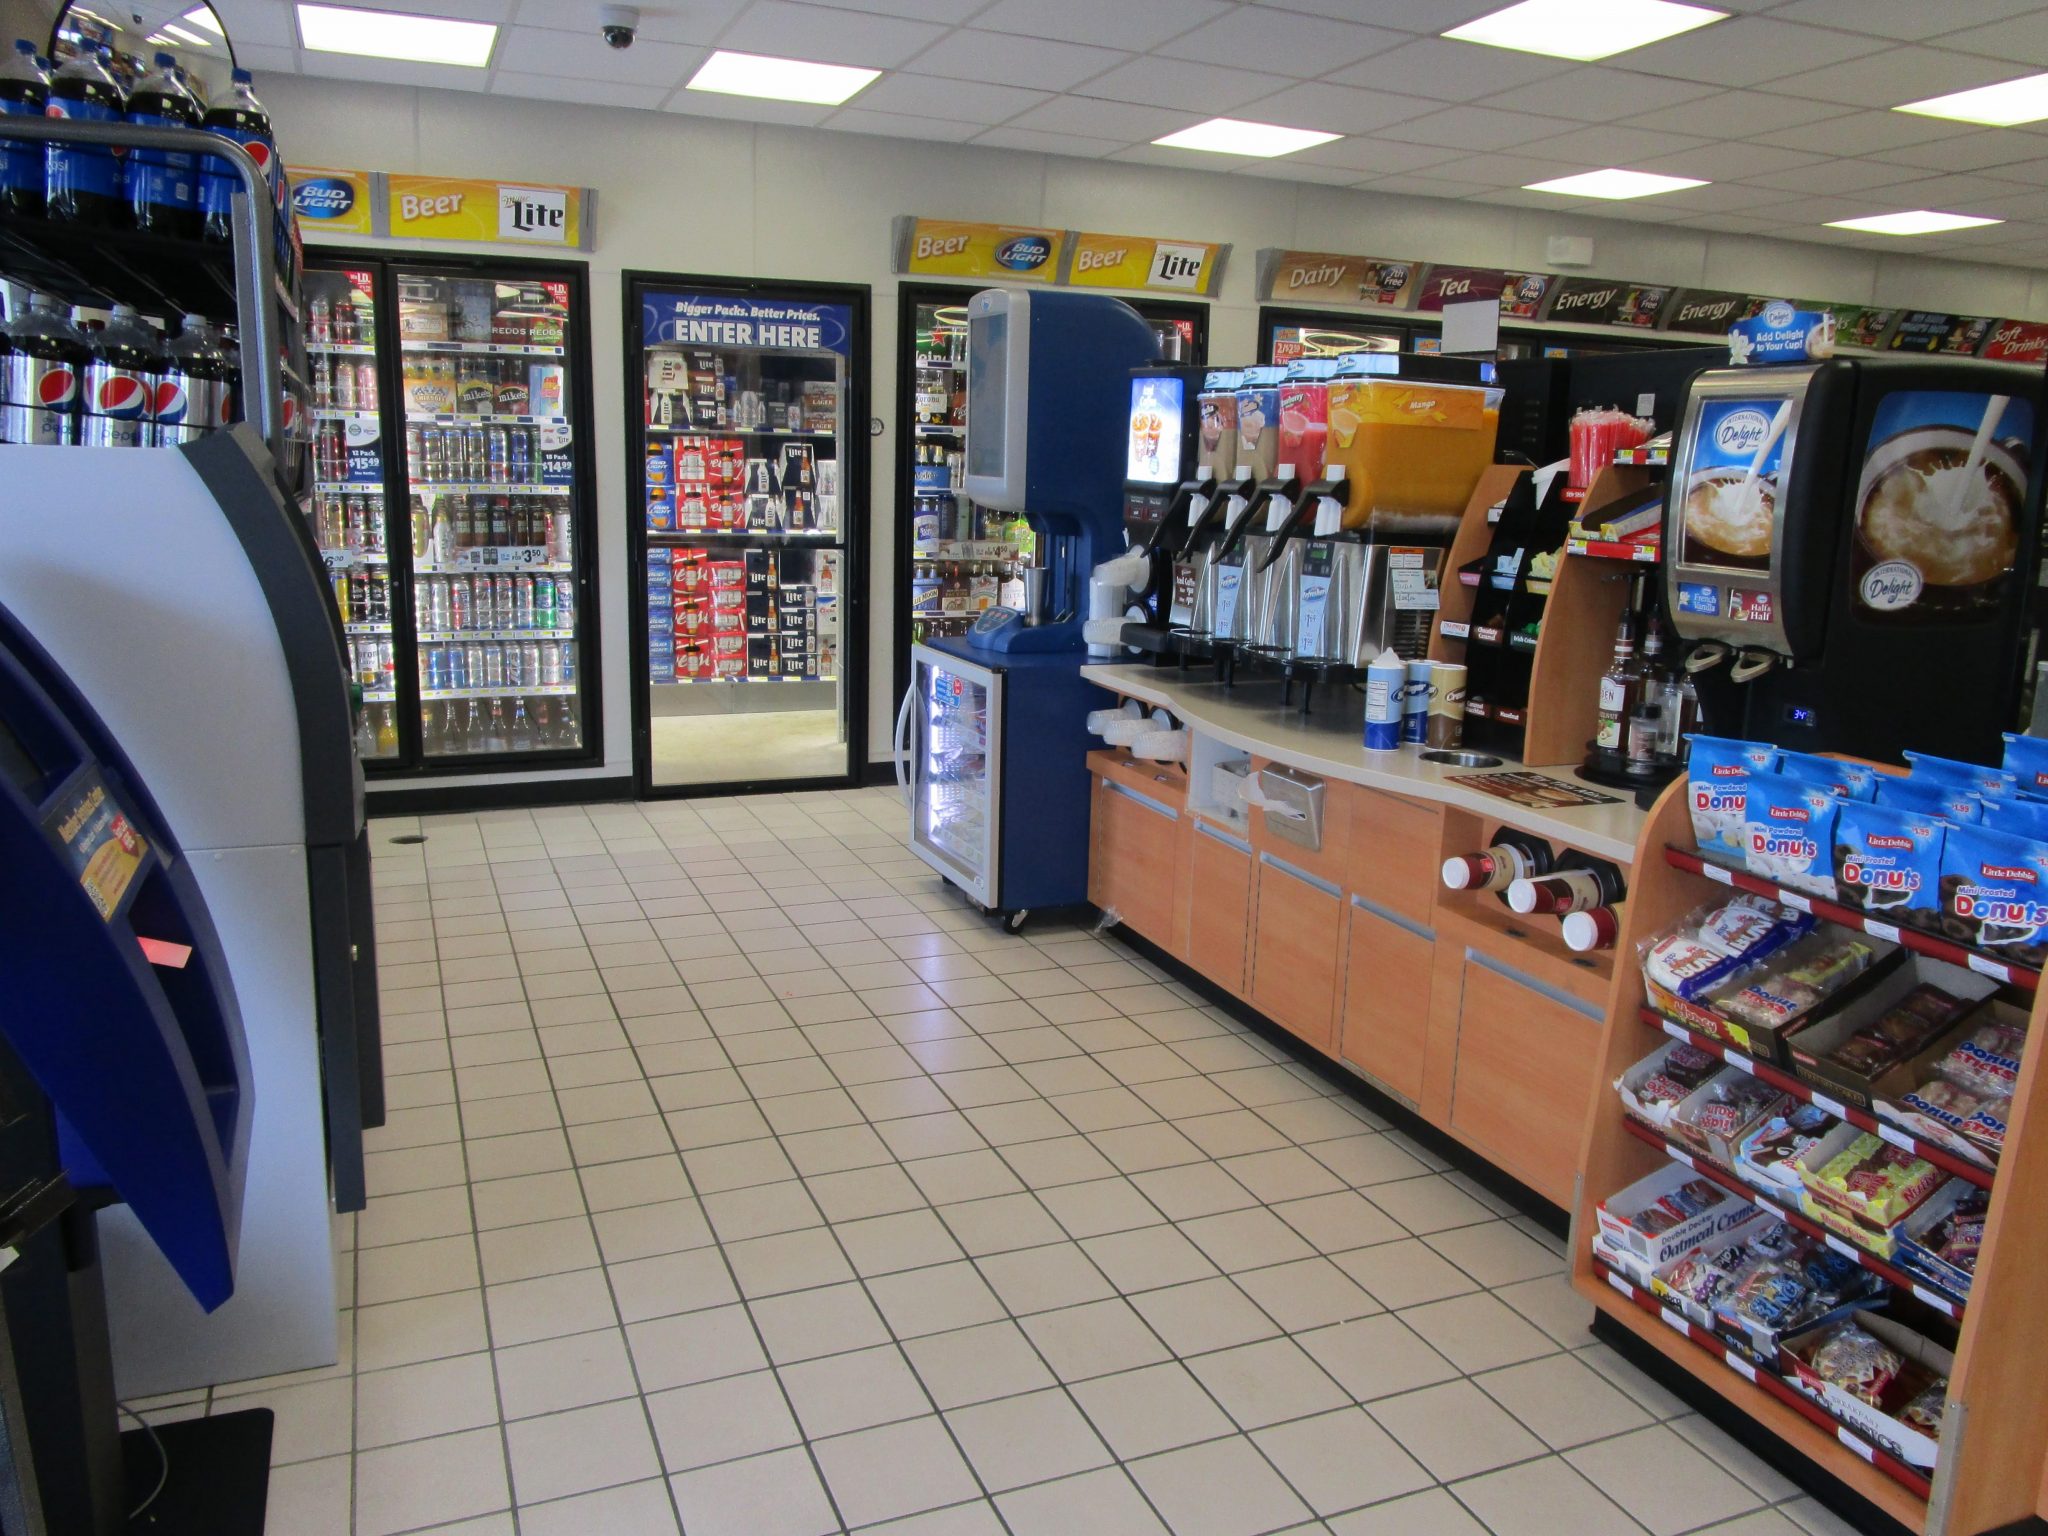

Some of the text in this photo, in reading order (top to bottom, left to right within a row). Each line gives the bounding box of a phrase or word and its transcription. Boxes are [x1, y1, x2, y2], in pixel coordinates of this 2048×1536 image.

[302, 186, 346, 199] BUD
[294, 196, 351, 209] LIGHT
[401, 192, 463, 221] Beer
[512, 201, 564, 232] Lite
[916, 233, 969, 259] Beer
[1012, 243, 1044, 254] BUD
[1002, 252, 1047, 263] LIGHT
[1077, 248, 1127, 272] Beer
[1159, 254, 1201, 281] Lite
[1389, 268, 1404, 278] 7th
[1289, 263, 1346, 288] Dairy
[1384, 276, 1404, 286] Free
[1439, 277, 1471, 297] Tea
[1527, 280, 1540, 290] 7th
[1520, 289, 1539, 298] Free
[1556, 287, 1619, 310] Energy
[1641, 300, 1658, 309] Free
[1679, 301, 1736, 321] Energy
[675, 302, 821, 321] Bigger Packs. Better Prices.
[674, 319, 820, 349] ENTER HERE
[1756, 329, 1804, 341] Add Delight
[1991, 326, 2022, 345] Soft
[1757, 340, 1803, 352] to Your Cup!
[2003, 337, 2046, 355] Drinks
[661, 359, 676, 382] Lite
[699, 360, 714, 370] Lite
[701, 384, 715, 394] Lite
[1409, 400, 1436, 410] Mango
[702, 409, 717, 418] Lite
[1722, 421, 1763, 449] Delight
[553, 454, 568, 462] Pack
[788, 448, 802, 457] Lite
[752, 517, 765, 526] Lite
[751, 573, 766, 582] Lite
[1869, 575, 1913, 604] Delight
[785, 592, 802, 602] Lite
[1694, 593, 1717, 604] French
[751, 616, 766, 625] Lite
[786, 615, 803, 625] Lite
[1750, 611, 1770, 621] Half
[786, 638, 803, 648] Lite
[753, 658, 768, 667] Lite
[787, 661, 804, 670] Lite
[1712, 784, 1747, 792] Powdered
[1696, 793, 1746, 811] Donu
[1771, 808, 1808, 820] Little Debbie
[1768, 827, 1803, 836] Powdered
[1753, 834, 1817, 857] Donuts
[1868, 836, 1912, 849] Little Debbie
[1846, 855, 1895, 865] Mini Frosted
[1844, 863, 1920, 889] Donuts
[1982, 866, 2035, 881] Little Debbie
[1957, 886, 2015, 898] Mini Frosted
[1955, 895, 2048, 925] Donuts
[1734, 917, 1773, 952] BUN
[1672, 952, 1720, 979] BUN
[1749, 985, 1798, 1012] DONUT
[1951, 1051, 2017, 1081] STICKS
[1903, 1093, 1964, 1127] DONUT
[1962, 1120, 2006, 1142] STIC
[1661, 1214, 1713, 1245] Double Decker
[1659, 1224, 1715, 1263] Oatmeal
